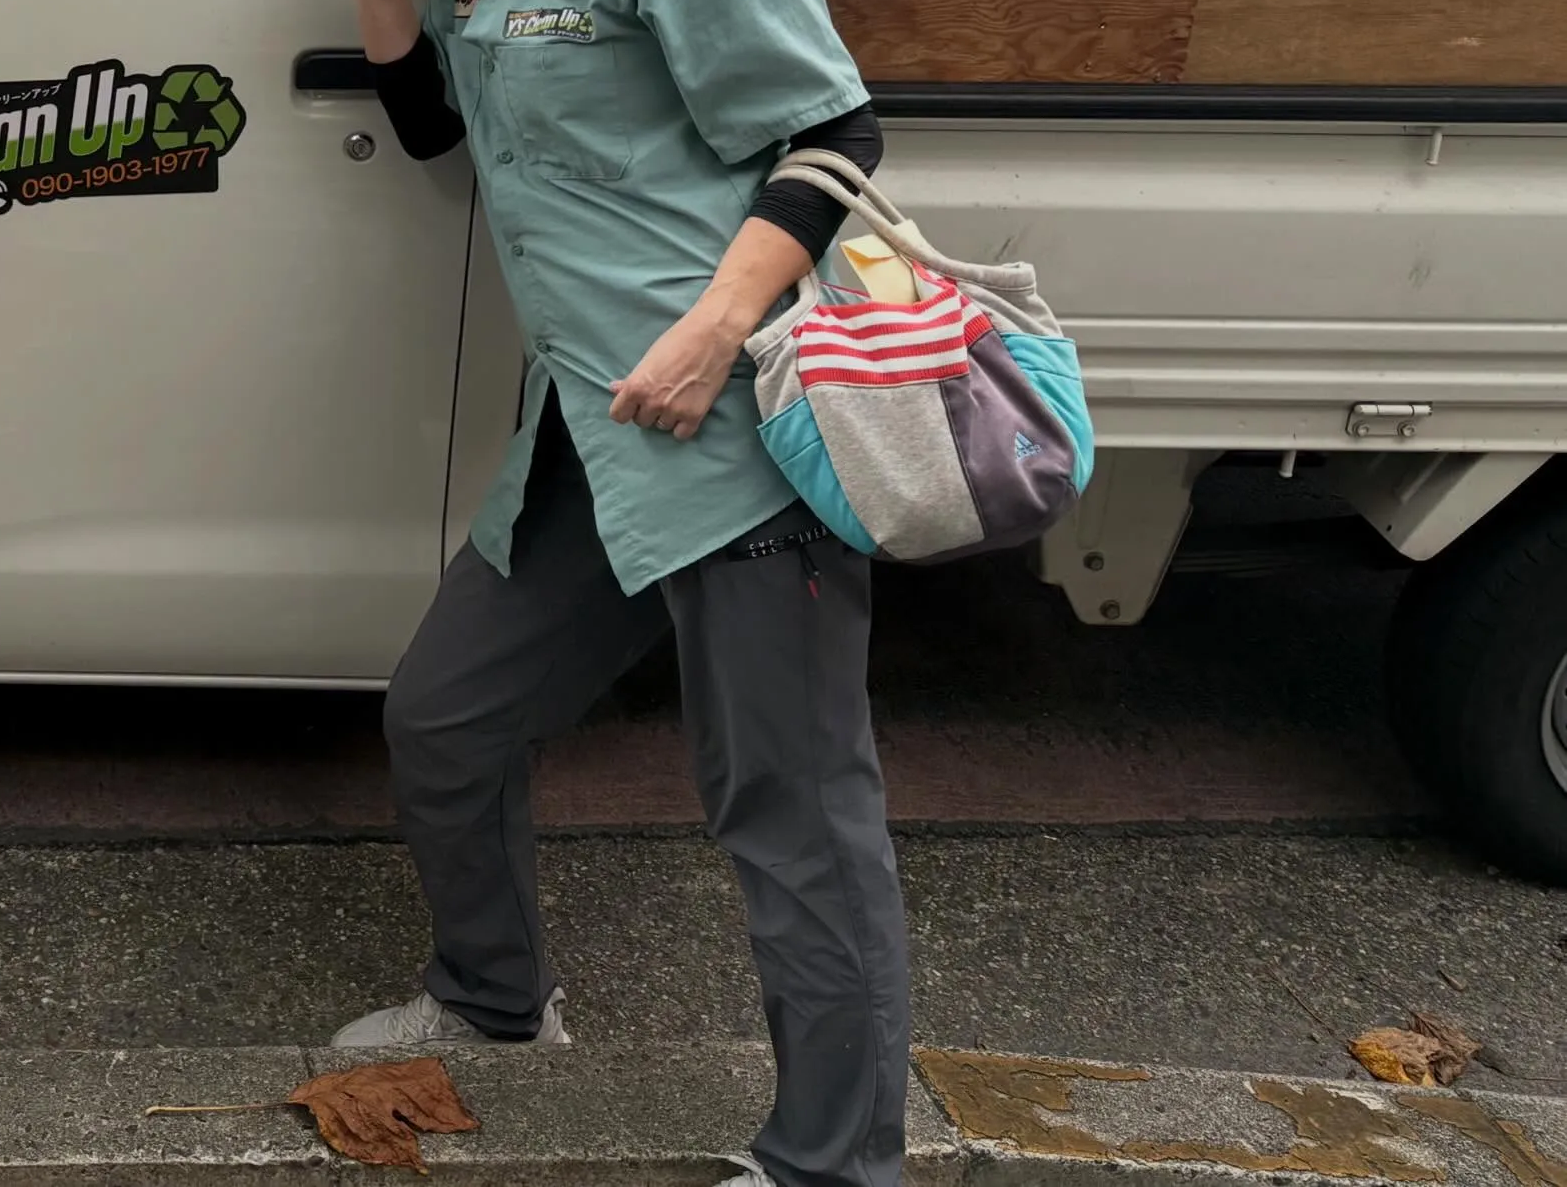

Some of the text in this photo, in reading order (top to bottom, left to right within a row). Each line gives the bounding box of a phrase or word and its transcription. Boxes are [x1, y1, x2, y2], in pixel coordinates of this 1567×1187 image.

[558, 8, 581, 31] Up
[69, 68, 149, 161] Up
[21, 146, 211, 200] 090-1903-1977
